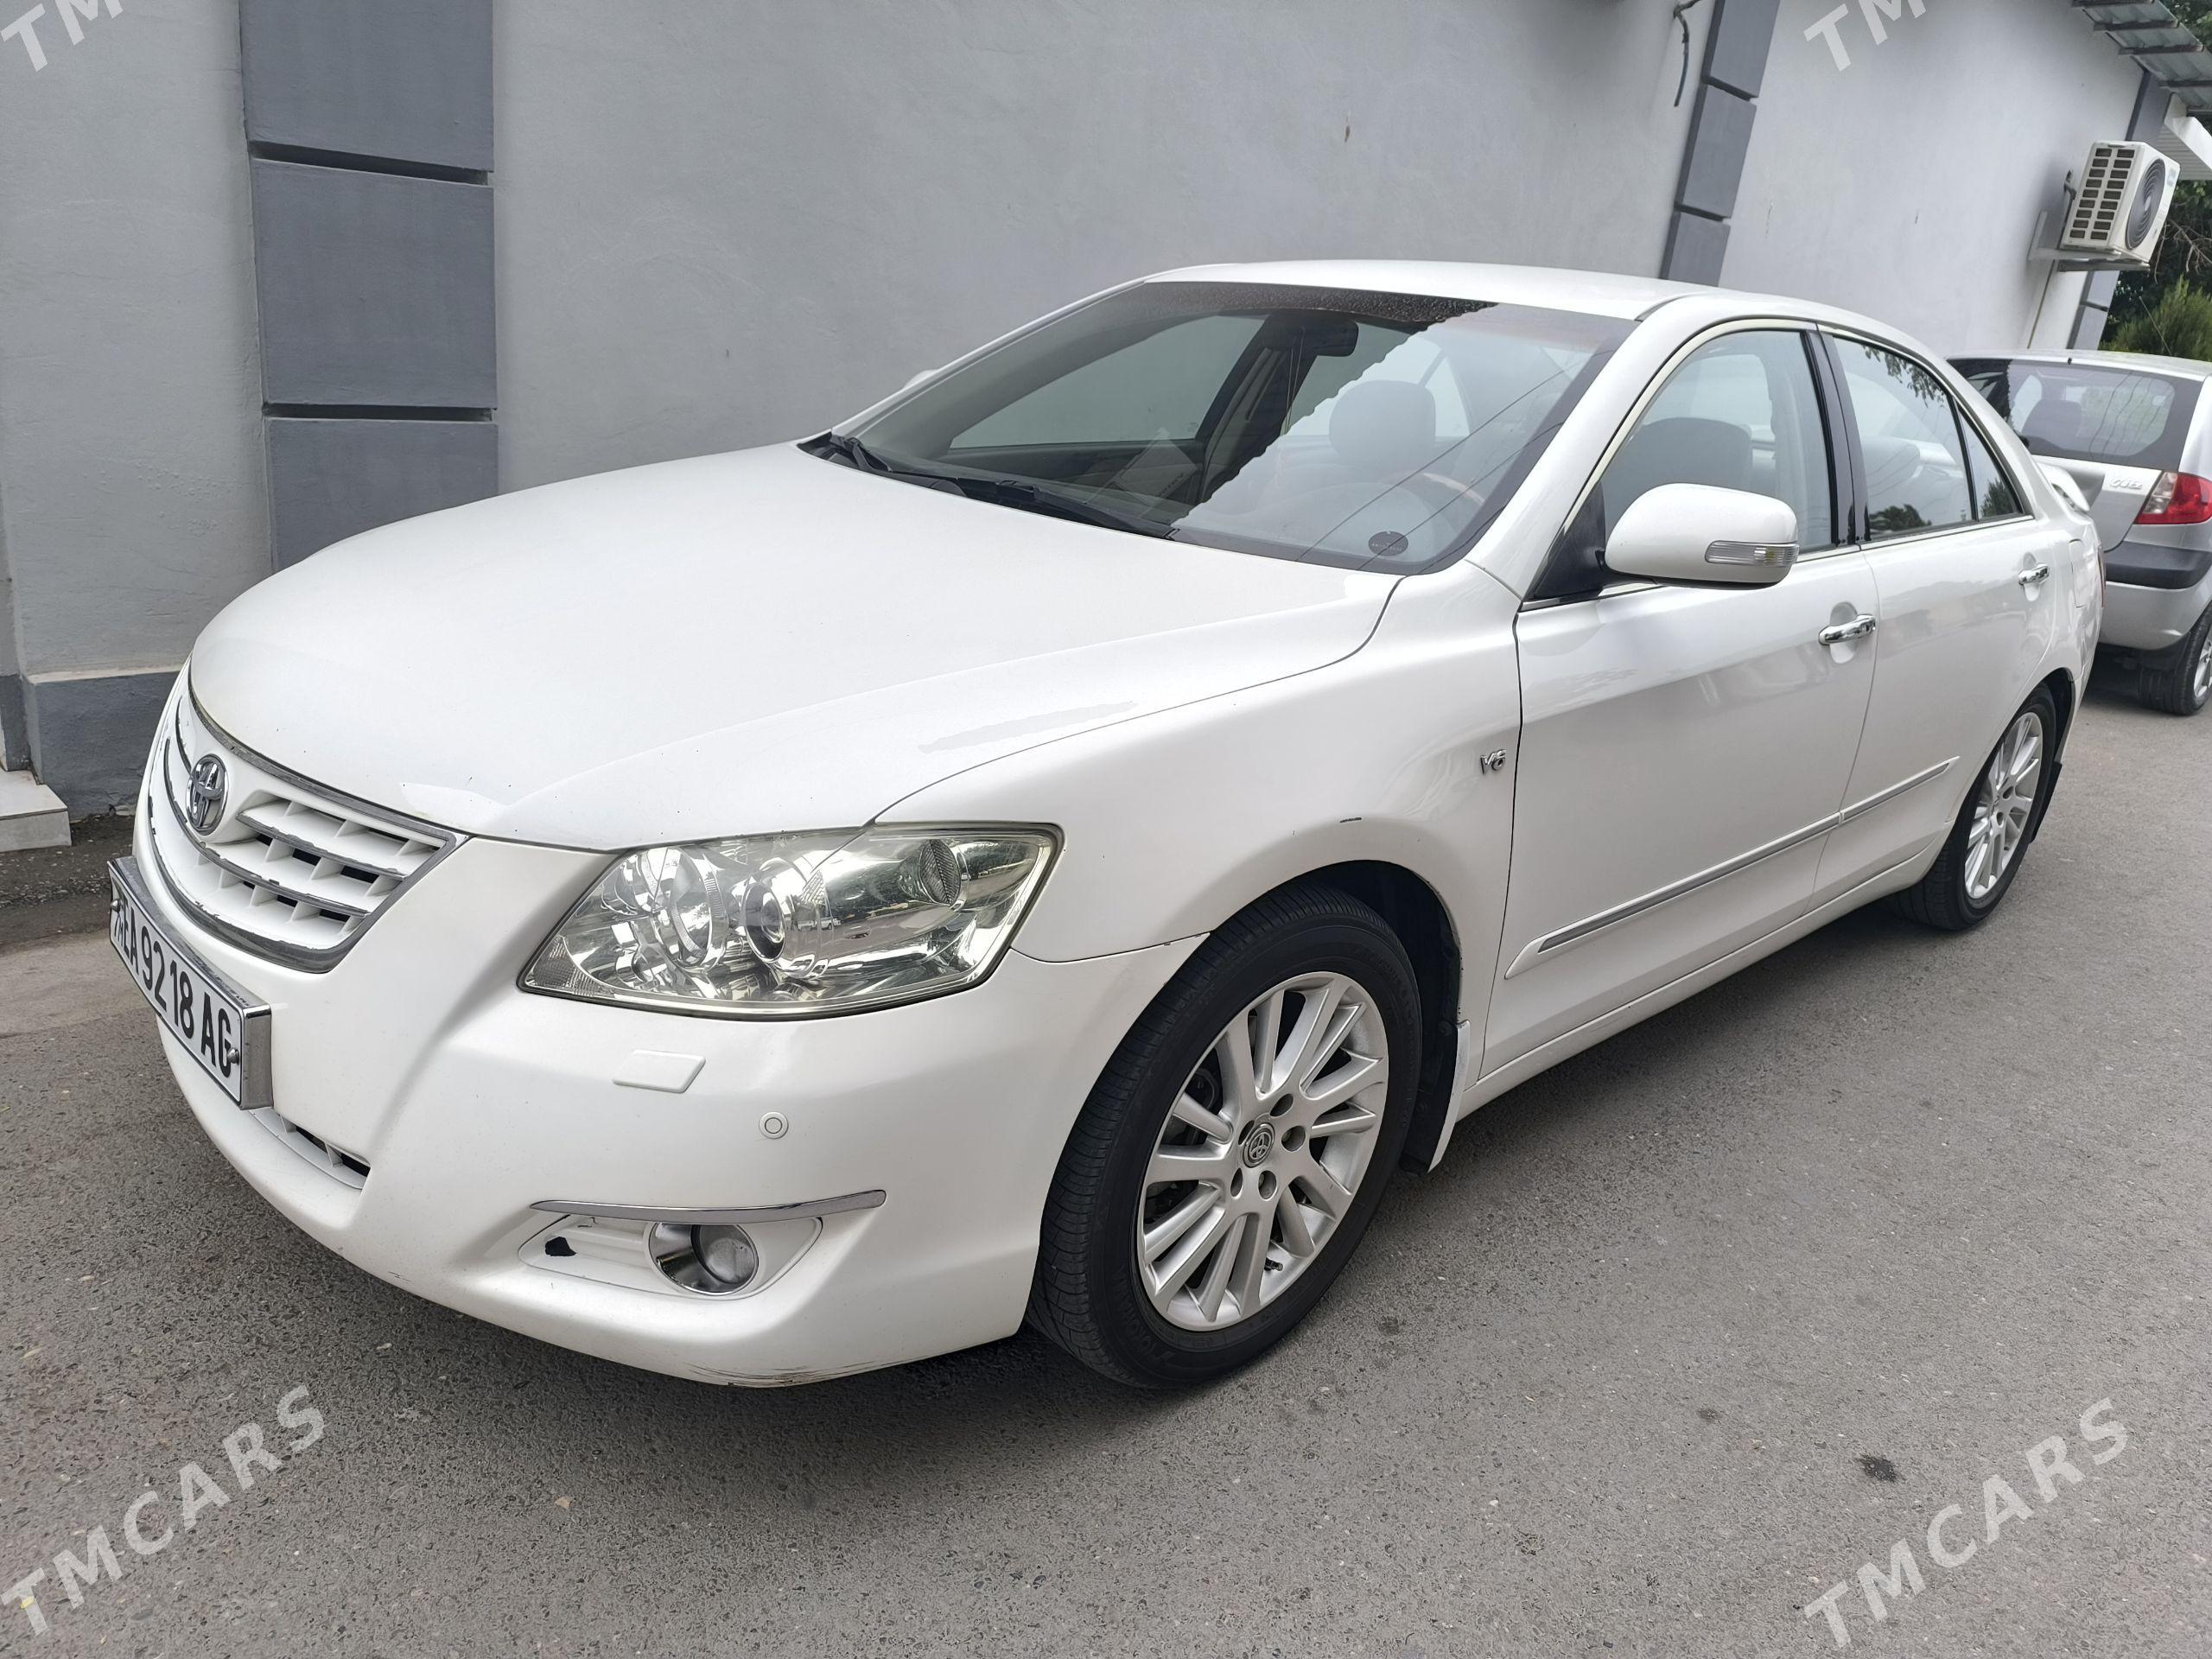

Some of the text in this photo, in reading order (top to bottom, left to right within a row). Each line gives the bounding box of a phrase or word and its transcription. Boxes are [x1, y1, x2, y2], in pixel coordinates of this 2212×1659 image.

[1479, 748, 1506, 774] V6
[141, 925, 194, 1039] 9218
[200, 991, 232, 1077] AG
